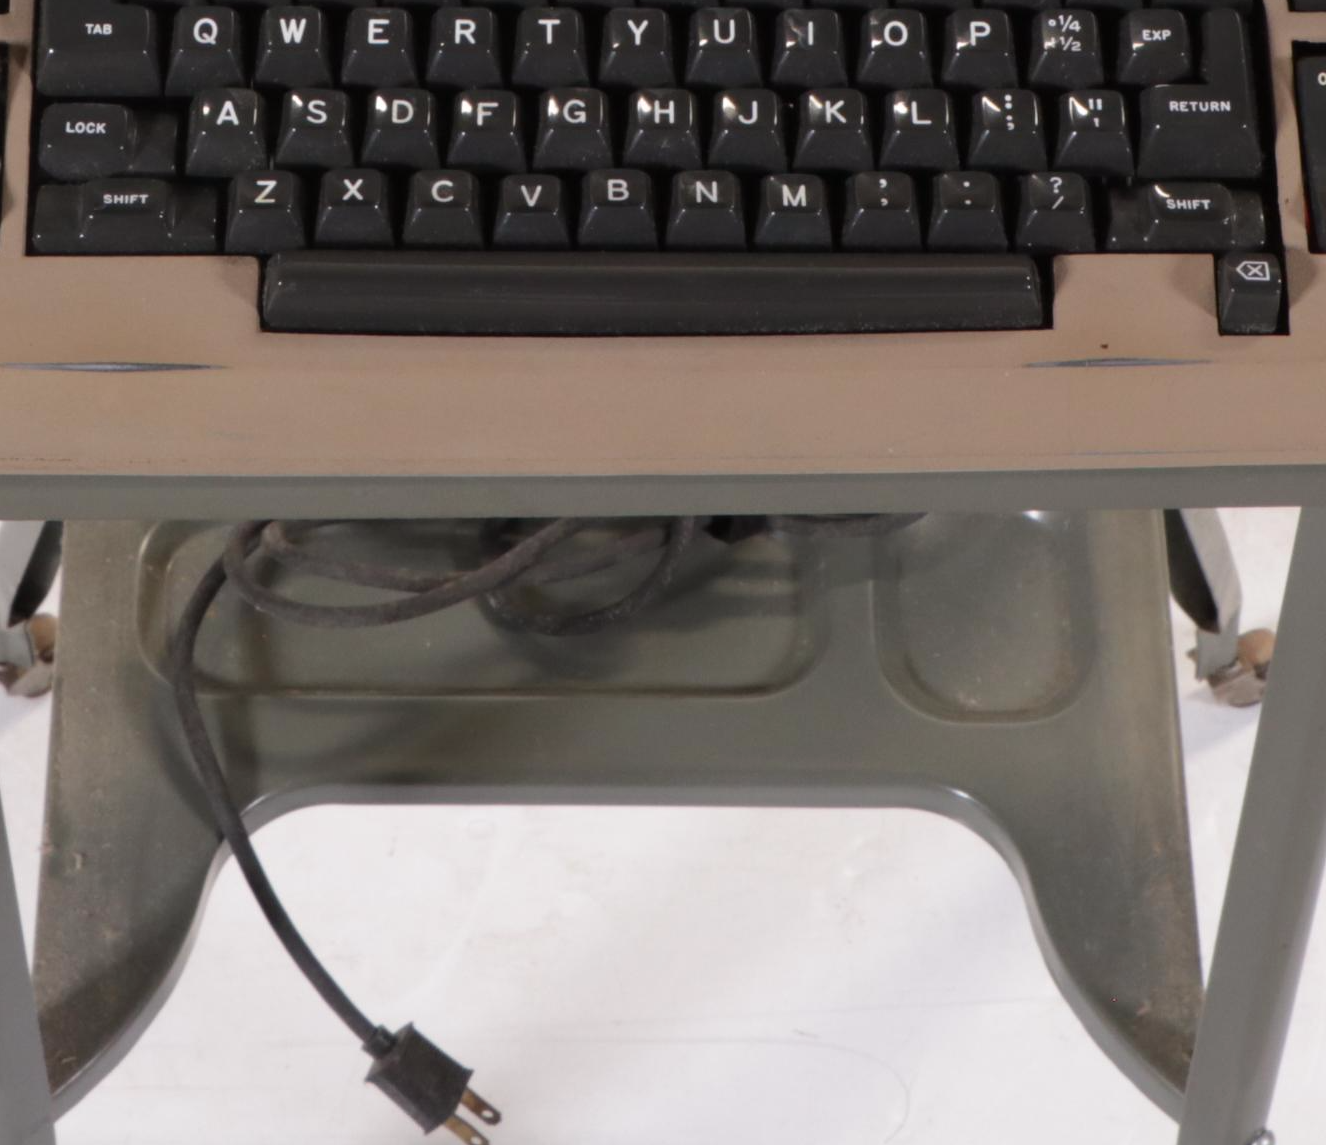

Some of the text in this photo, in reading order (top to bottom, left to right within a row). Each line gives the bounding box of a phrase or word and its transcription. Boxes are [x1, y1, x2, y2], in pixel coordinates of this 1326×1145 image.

[86, 24, 112, 34] TAB
[194, 18, 217, 44] Q
[280, 19, 306, 43] W
[368, 19, 389, 44] E
[455, 19, 475, 43] R
[538, 19, 560, 44] T
[628, 20, 648, 45] Y
[714, 20, 735, 43] U
[807, 22, 814, 45] I
[881, 21, 908, 46] O
[968, 21, 990, 46] P
[1142, 30, 1171, 41] EXP
[217, 101, 238, 125] A
[307, 100, 327, 123] S
[392, 100, 413, 123] D
[477, 103, 498, 125] F
[563, 100, 586, 123] G
[654, 100, 674, 123] H
[739, 101, 757, 124] J
[825, 101, 846, 123] K
[911, 101, 931, 124] L
[1170, 101, 1230, 111] RETURN
[66, 122, 105, 133] LOCK
[255, 181, 276, 202] Z
[343, 179, 362, 200] X
[432, 180, 453, 202] C
[521, 186, 541, 206] V
[608, 180, 629, 200] B
[696, 181, 717, 202] N
[782, 185, 806, 206] M
[1050, 177, 1062, 193] ?
[104, 194, 148, 203] SHIFT
[1165, 197, 1210, 209] SHIFT
